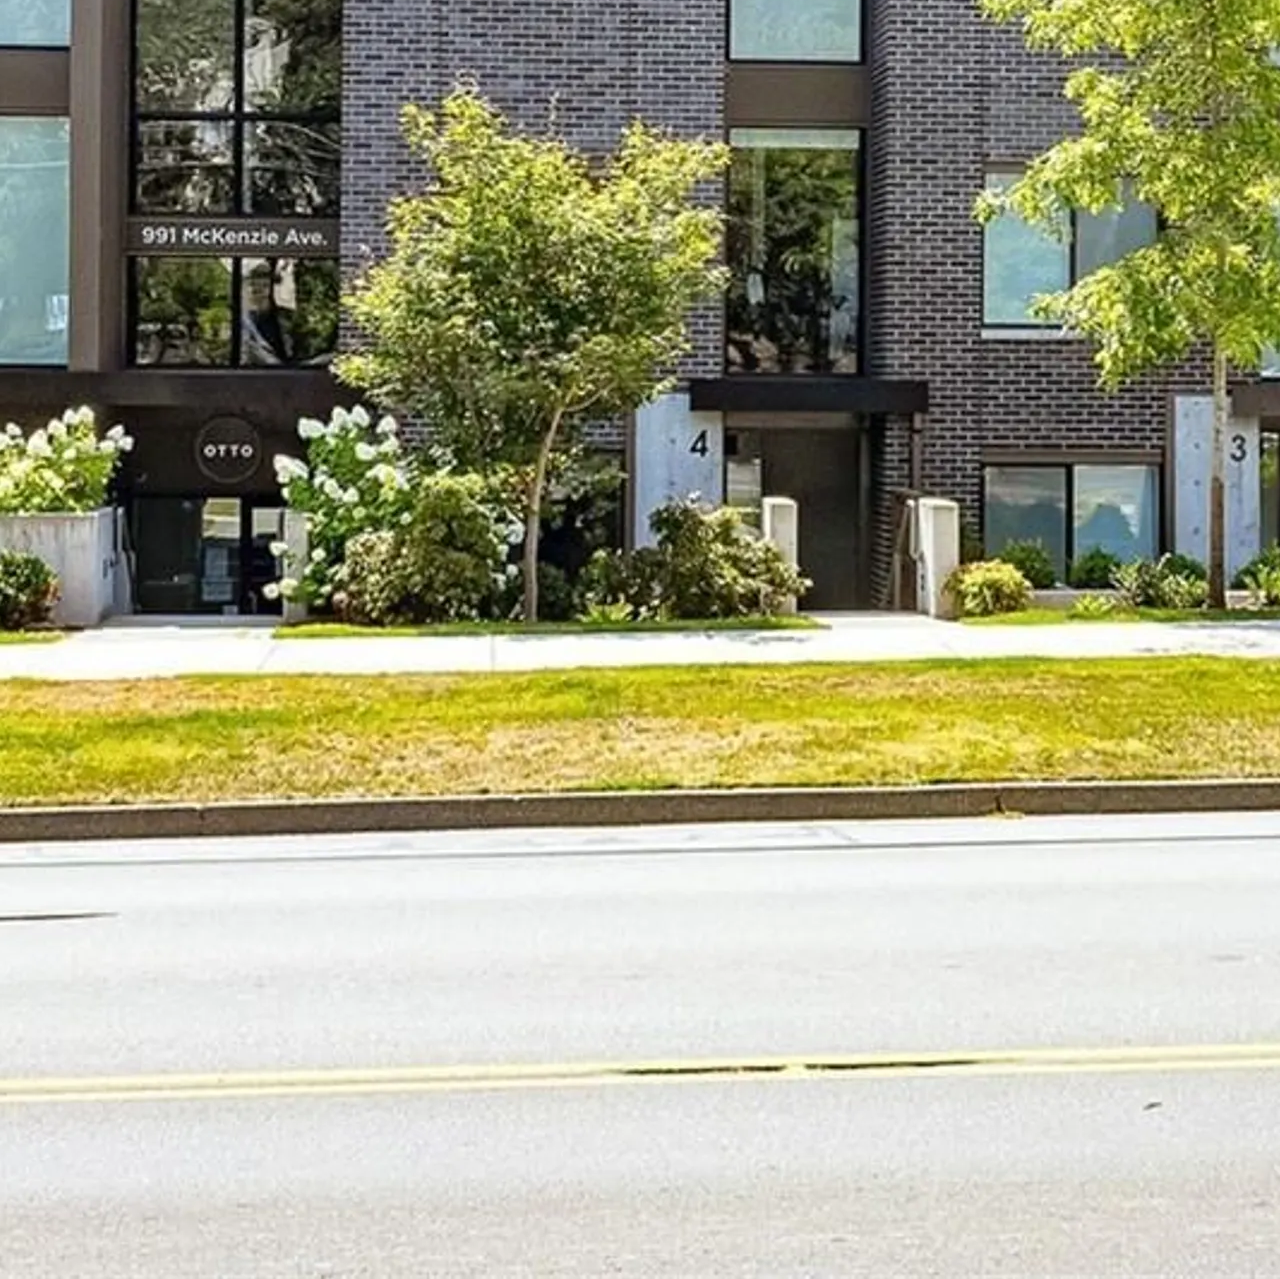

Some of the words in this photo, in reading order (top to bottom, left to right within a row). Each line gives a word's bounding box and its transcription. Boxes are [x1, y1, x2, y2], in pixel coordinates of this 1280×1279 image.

[141, 227, 176, 244] 991
[182, 228, 278, 245] McKenzie
[284, 228, 328, 245] Ave.
[203, 444, 253, 458] OTTO
[690, 430, 709, 457] 4
[1230, 434, 1247, 462] 3
